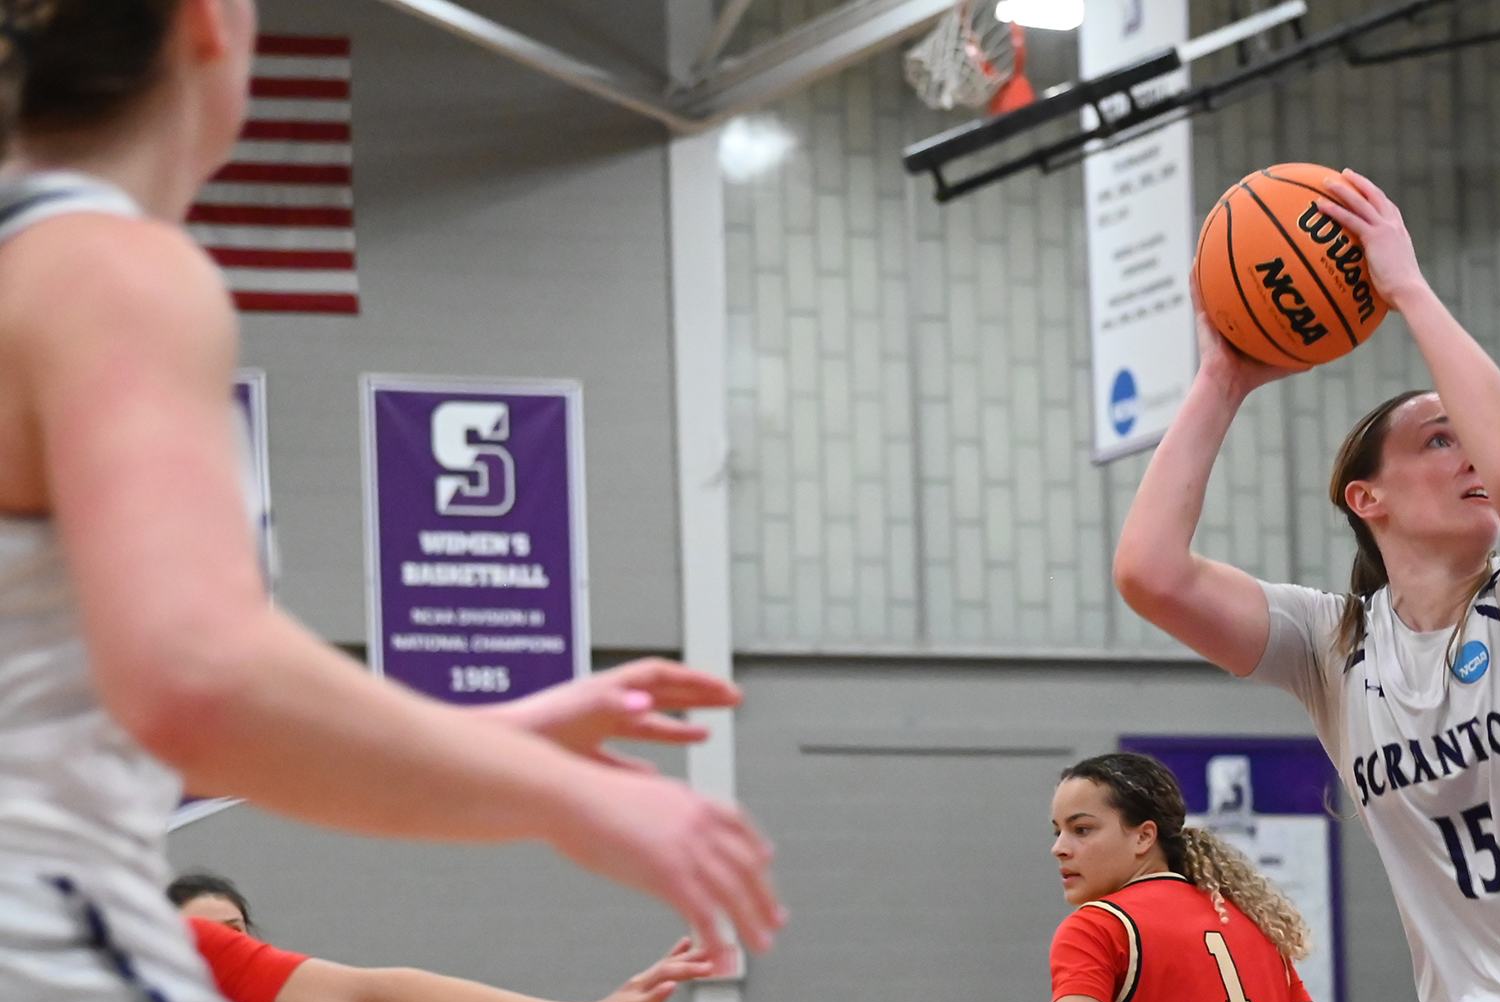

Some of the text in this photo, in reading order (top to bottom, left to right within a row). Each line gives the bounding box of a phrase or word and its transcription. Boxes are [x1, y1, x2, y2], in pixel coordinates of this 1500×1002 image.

[1296, 200, 1376, 325] Wilson
[1254, 257, 1329, 346] NCAA
[418, 530, 531, 557] WOMEN'S
[401, 561, 550, 589] BASKETBALL
[1459, 650, 1488, 679] NCAA
[450, 665, 511, 693] 1985
